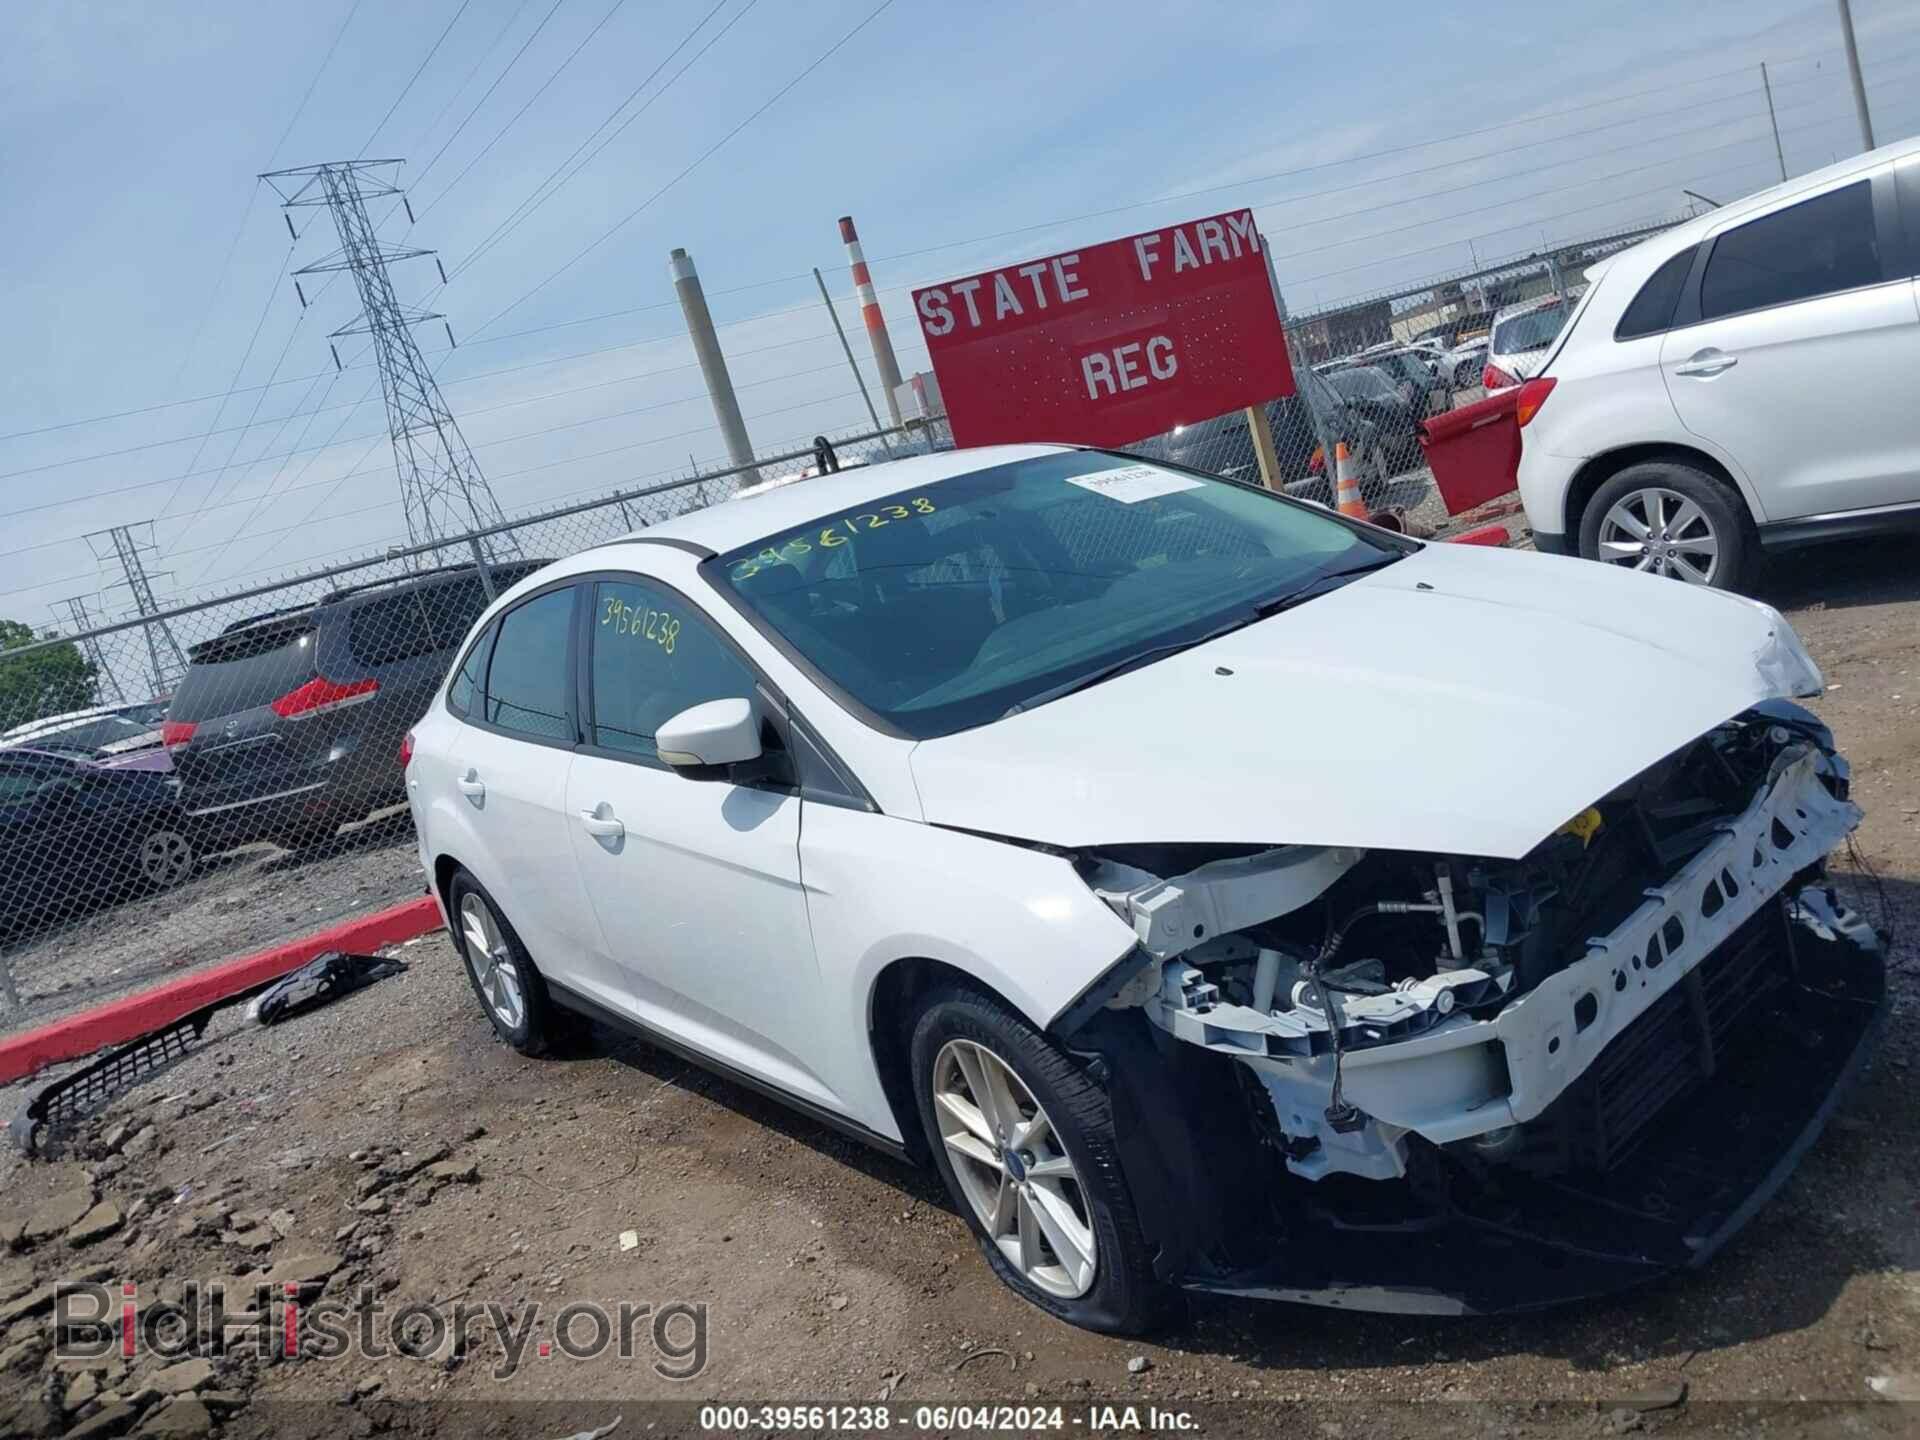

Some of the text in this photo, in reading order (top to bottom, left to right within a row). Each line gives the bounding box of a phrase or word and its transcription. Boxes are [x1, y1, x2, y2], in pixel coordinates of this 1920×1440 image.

[916, 211, 1263, 336] STATE FARM
[1080, 335, 1179, 400] REG
[726, 497, 936, 581] 39561238
[601, 597, 681, 654] 39561238
